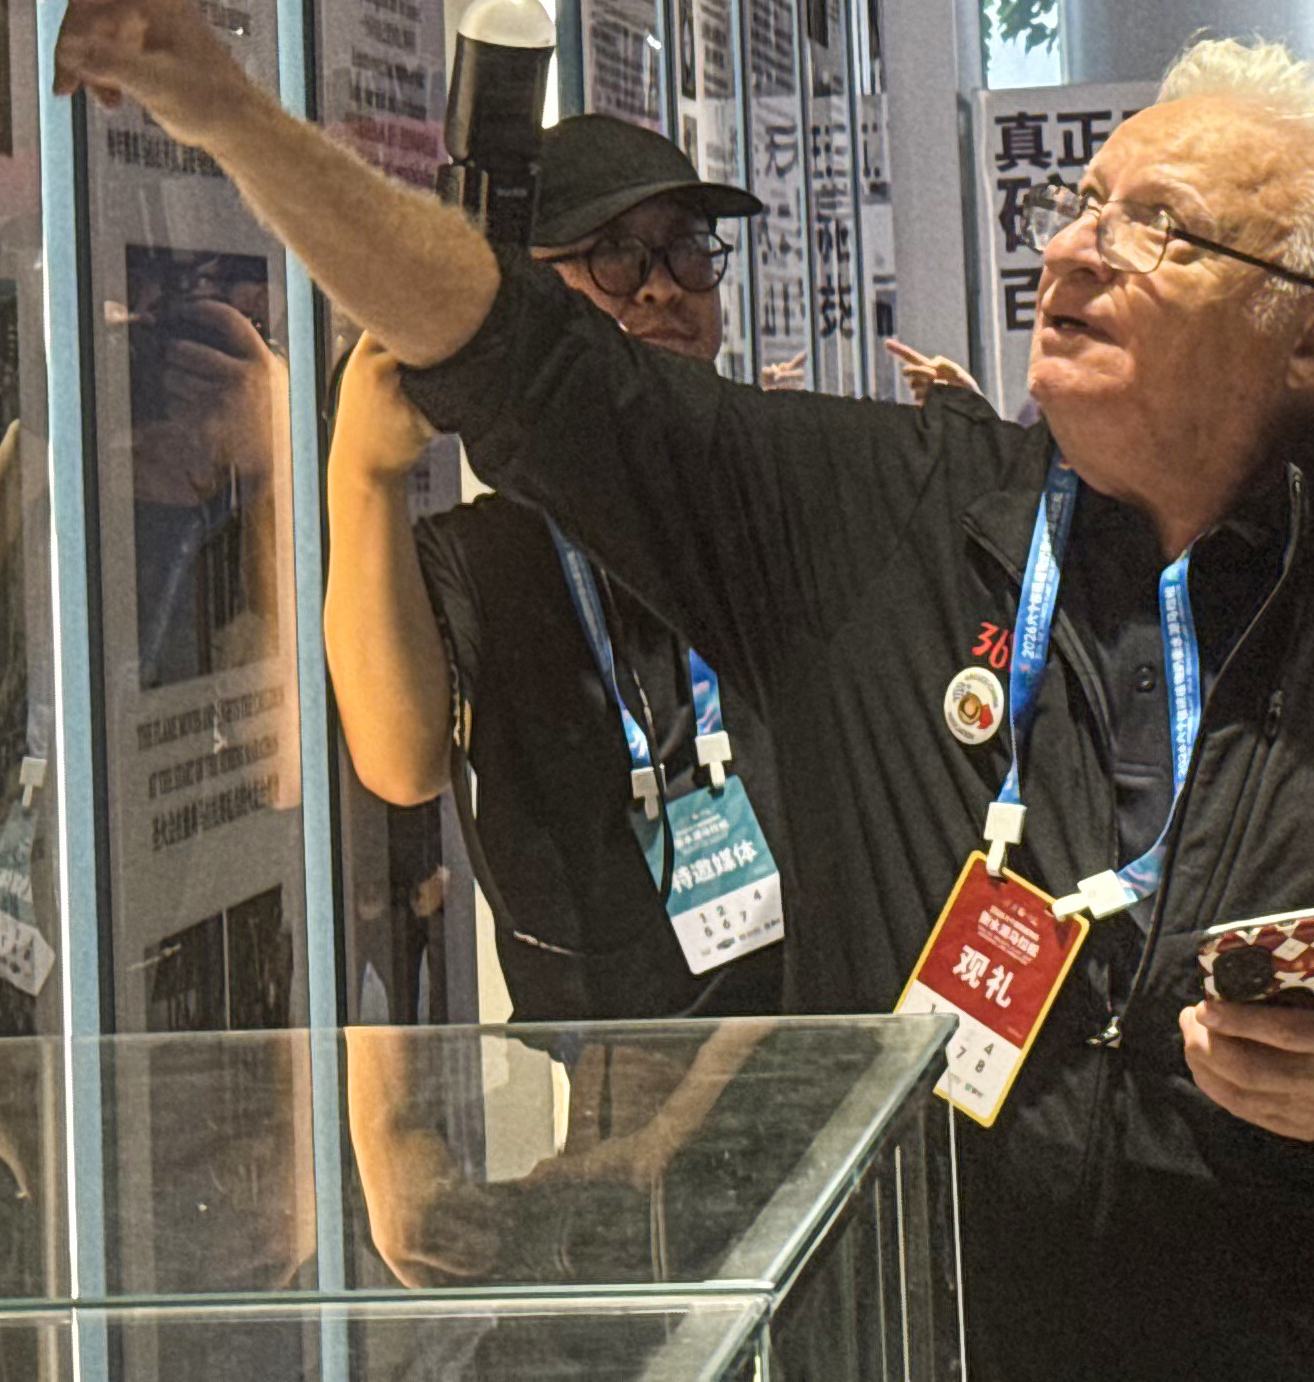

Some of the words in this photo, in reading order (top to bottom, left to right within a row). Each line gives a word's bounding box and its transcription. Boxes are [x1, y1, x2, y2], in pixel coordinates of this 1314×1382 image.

[672, 838, 758, 895] 特邀媒体
[951, 943, 1015, 1009] 观礼
